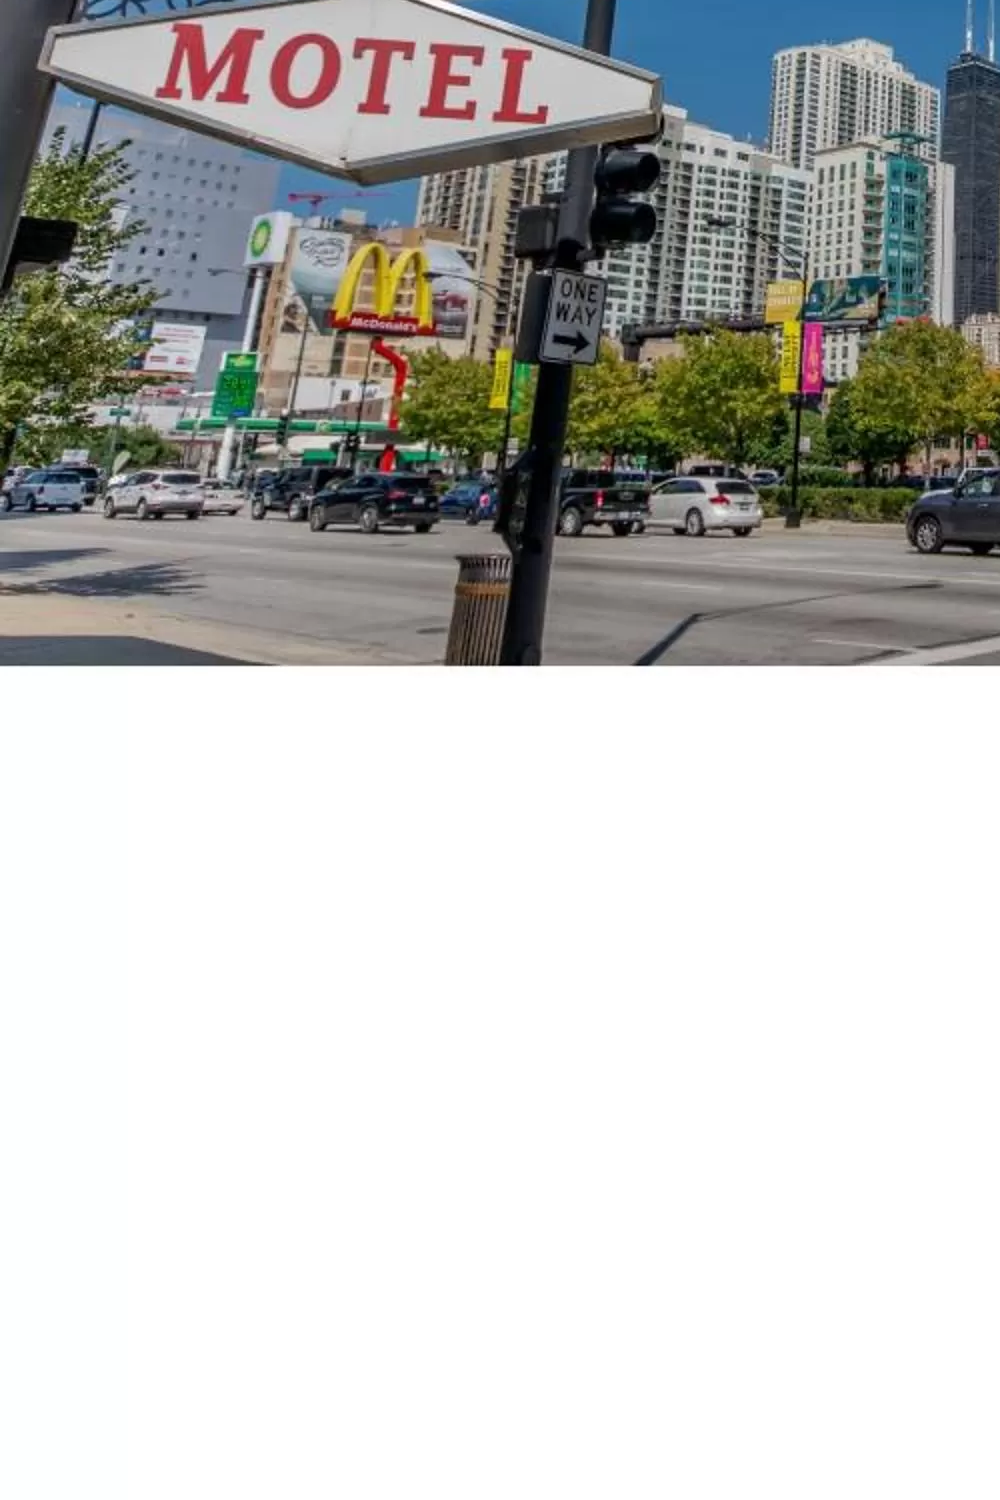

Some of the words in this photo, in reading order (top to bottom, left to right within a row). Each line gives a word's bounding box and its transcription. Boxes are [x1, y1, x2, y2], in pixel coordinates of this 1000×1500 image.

[156, 22, 549, 125] MOTEL
[561, 278, 599, 303] ONE
[350, 316, 417, 333] McDonald's
[555, 300, 597, 327] WAY
